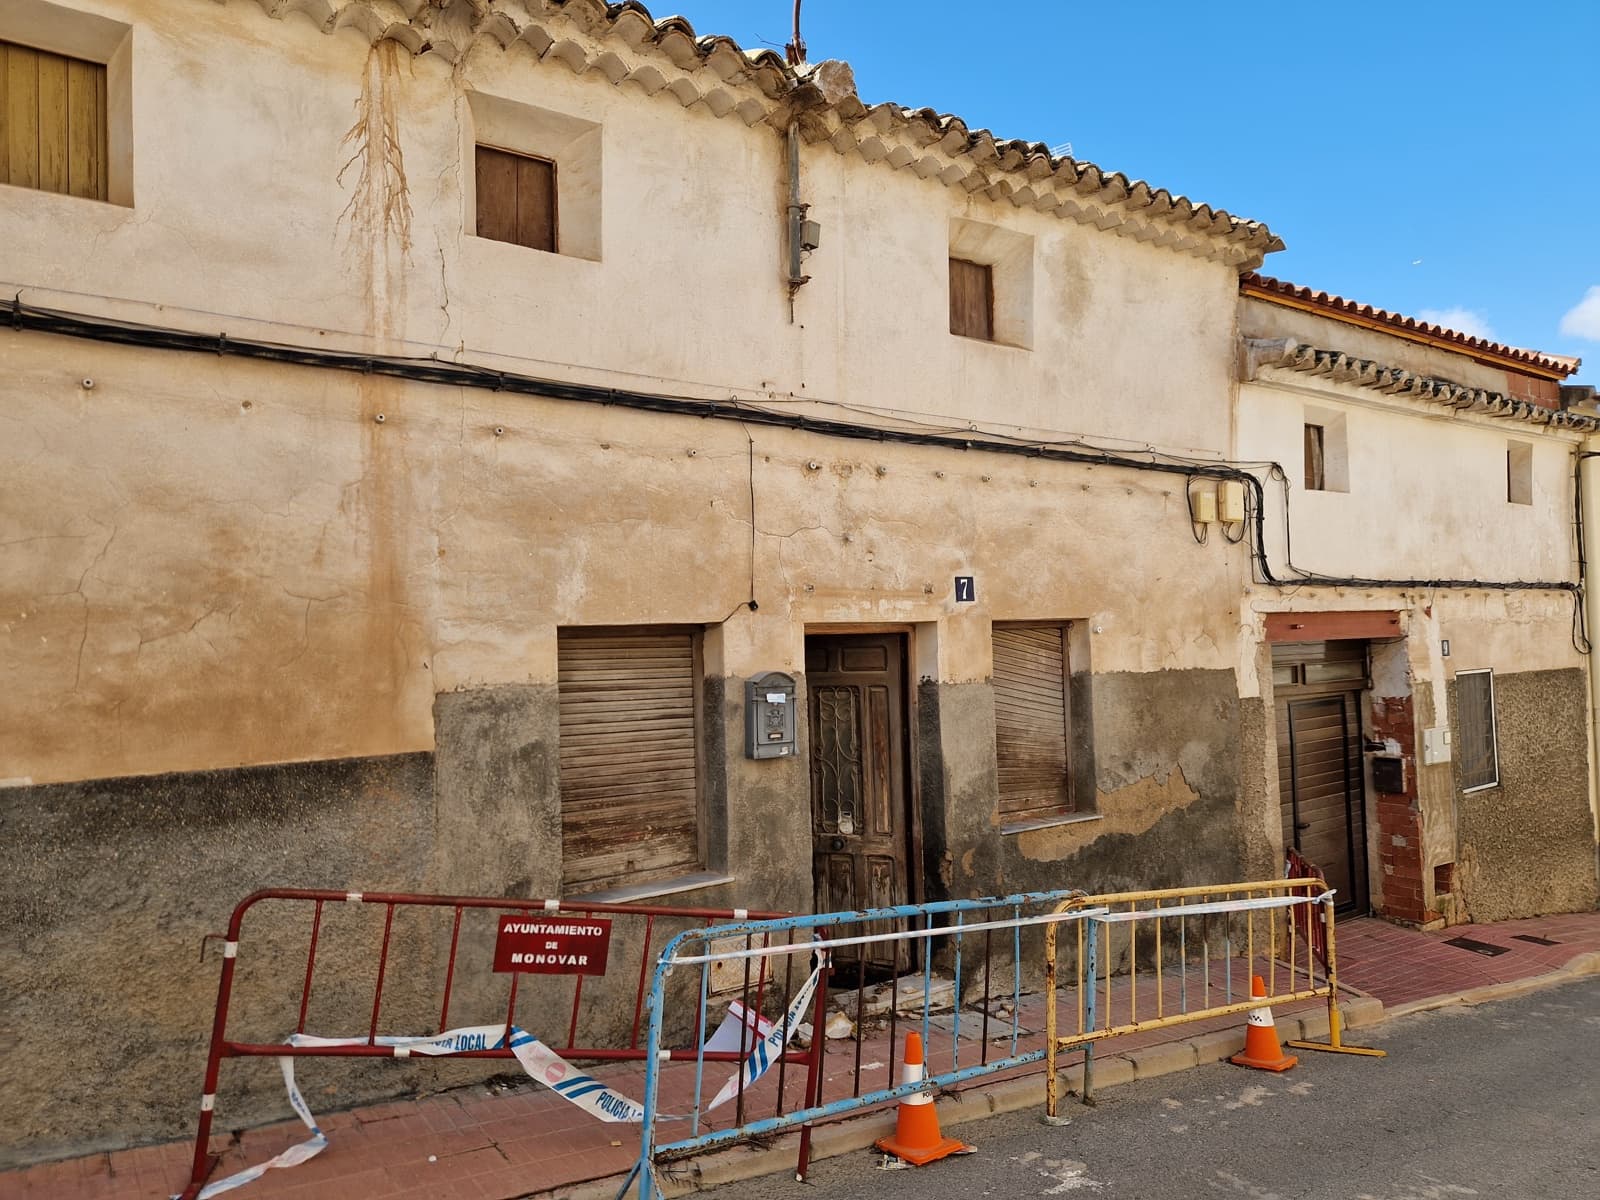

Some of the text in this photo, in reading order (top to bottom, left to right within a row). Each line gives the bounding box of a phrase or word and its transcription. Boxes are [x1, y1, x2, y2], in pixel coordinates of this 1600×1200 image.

[960, 578, 968, 600] 7
[503, 922, 603, 936] AYUNTAMIENTO
[545, 941, 558, 950] DE
[511, 952, 588, 966] MONOVAR
[455, 1034, 486, 1051] LOCAL
[595, 1091, 631, 1120] POLICIA
